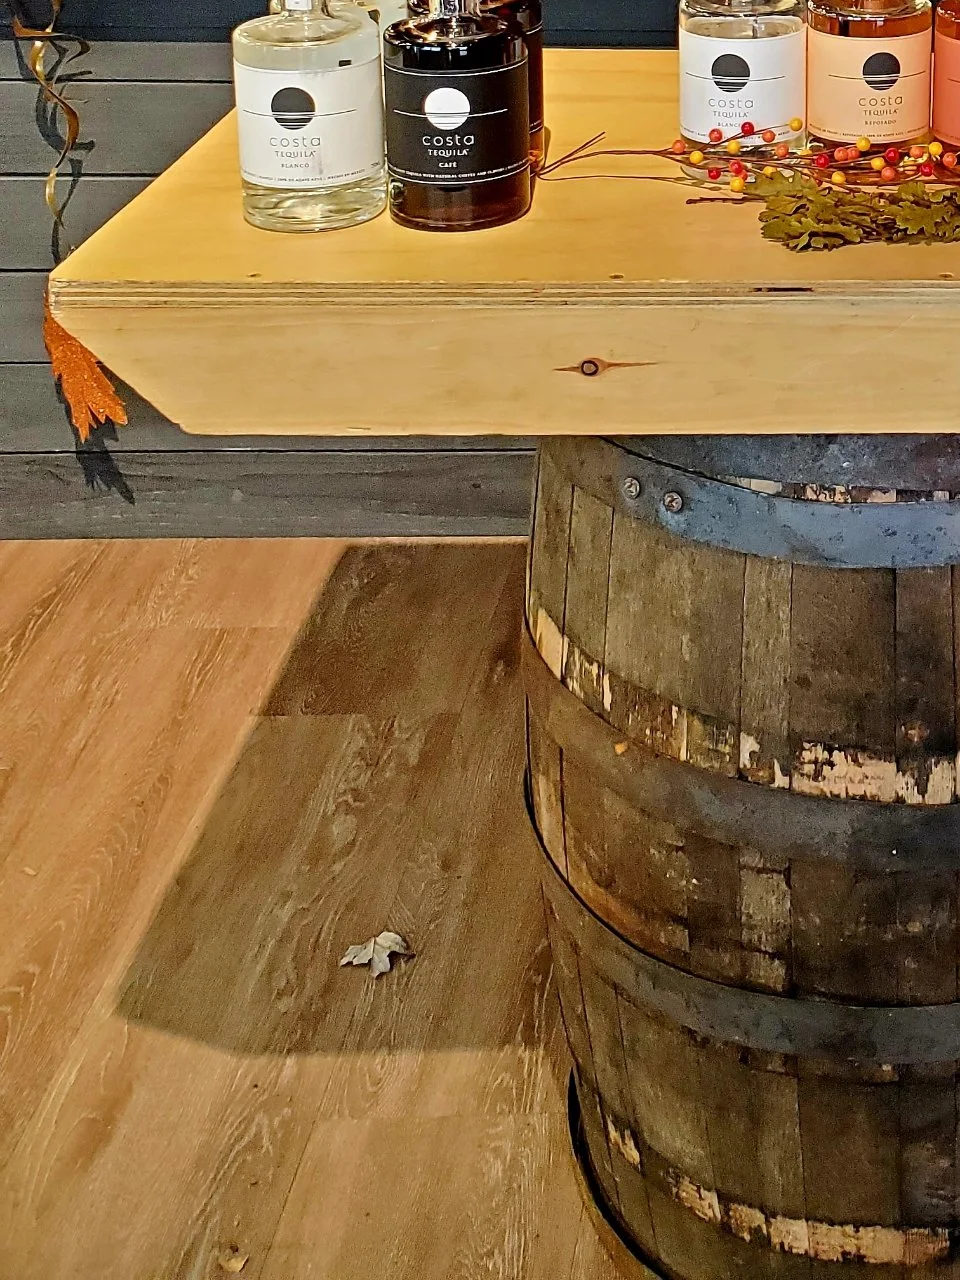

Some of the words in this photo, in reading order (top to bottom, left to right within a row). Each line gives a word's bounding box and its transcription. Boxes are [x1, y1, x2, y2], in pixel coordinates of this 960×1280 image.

[708, 98, 754, 109] costa
[858, 96, 903, 107] costa
[269, 136, 321, 148] costa
[422, 134, 475, 146] costa
[275, 150, 314, 159] TEQUILA
[428, 148, 469, 157] TEQUILA
